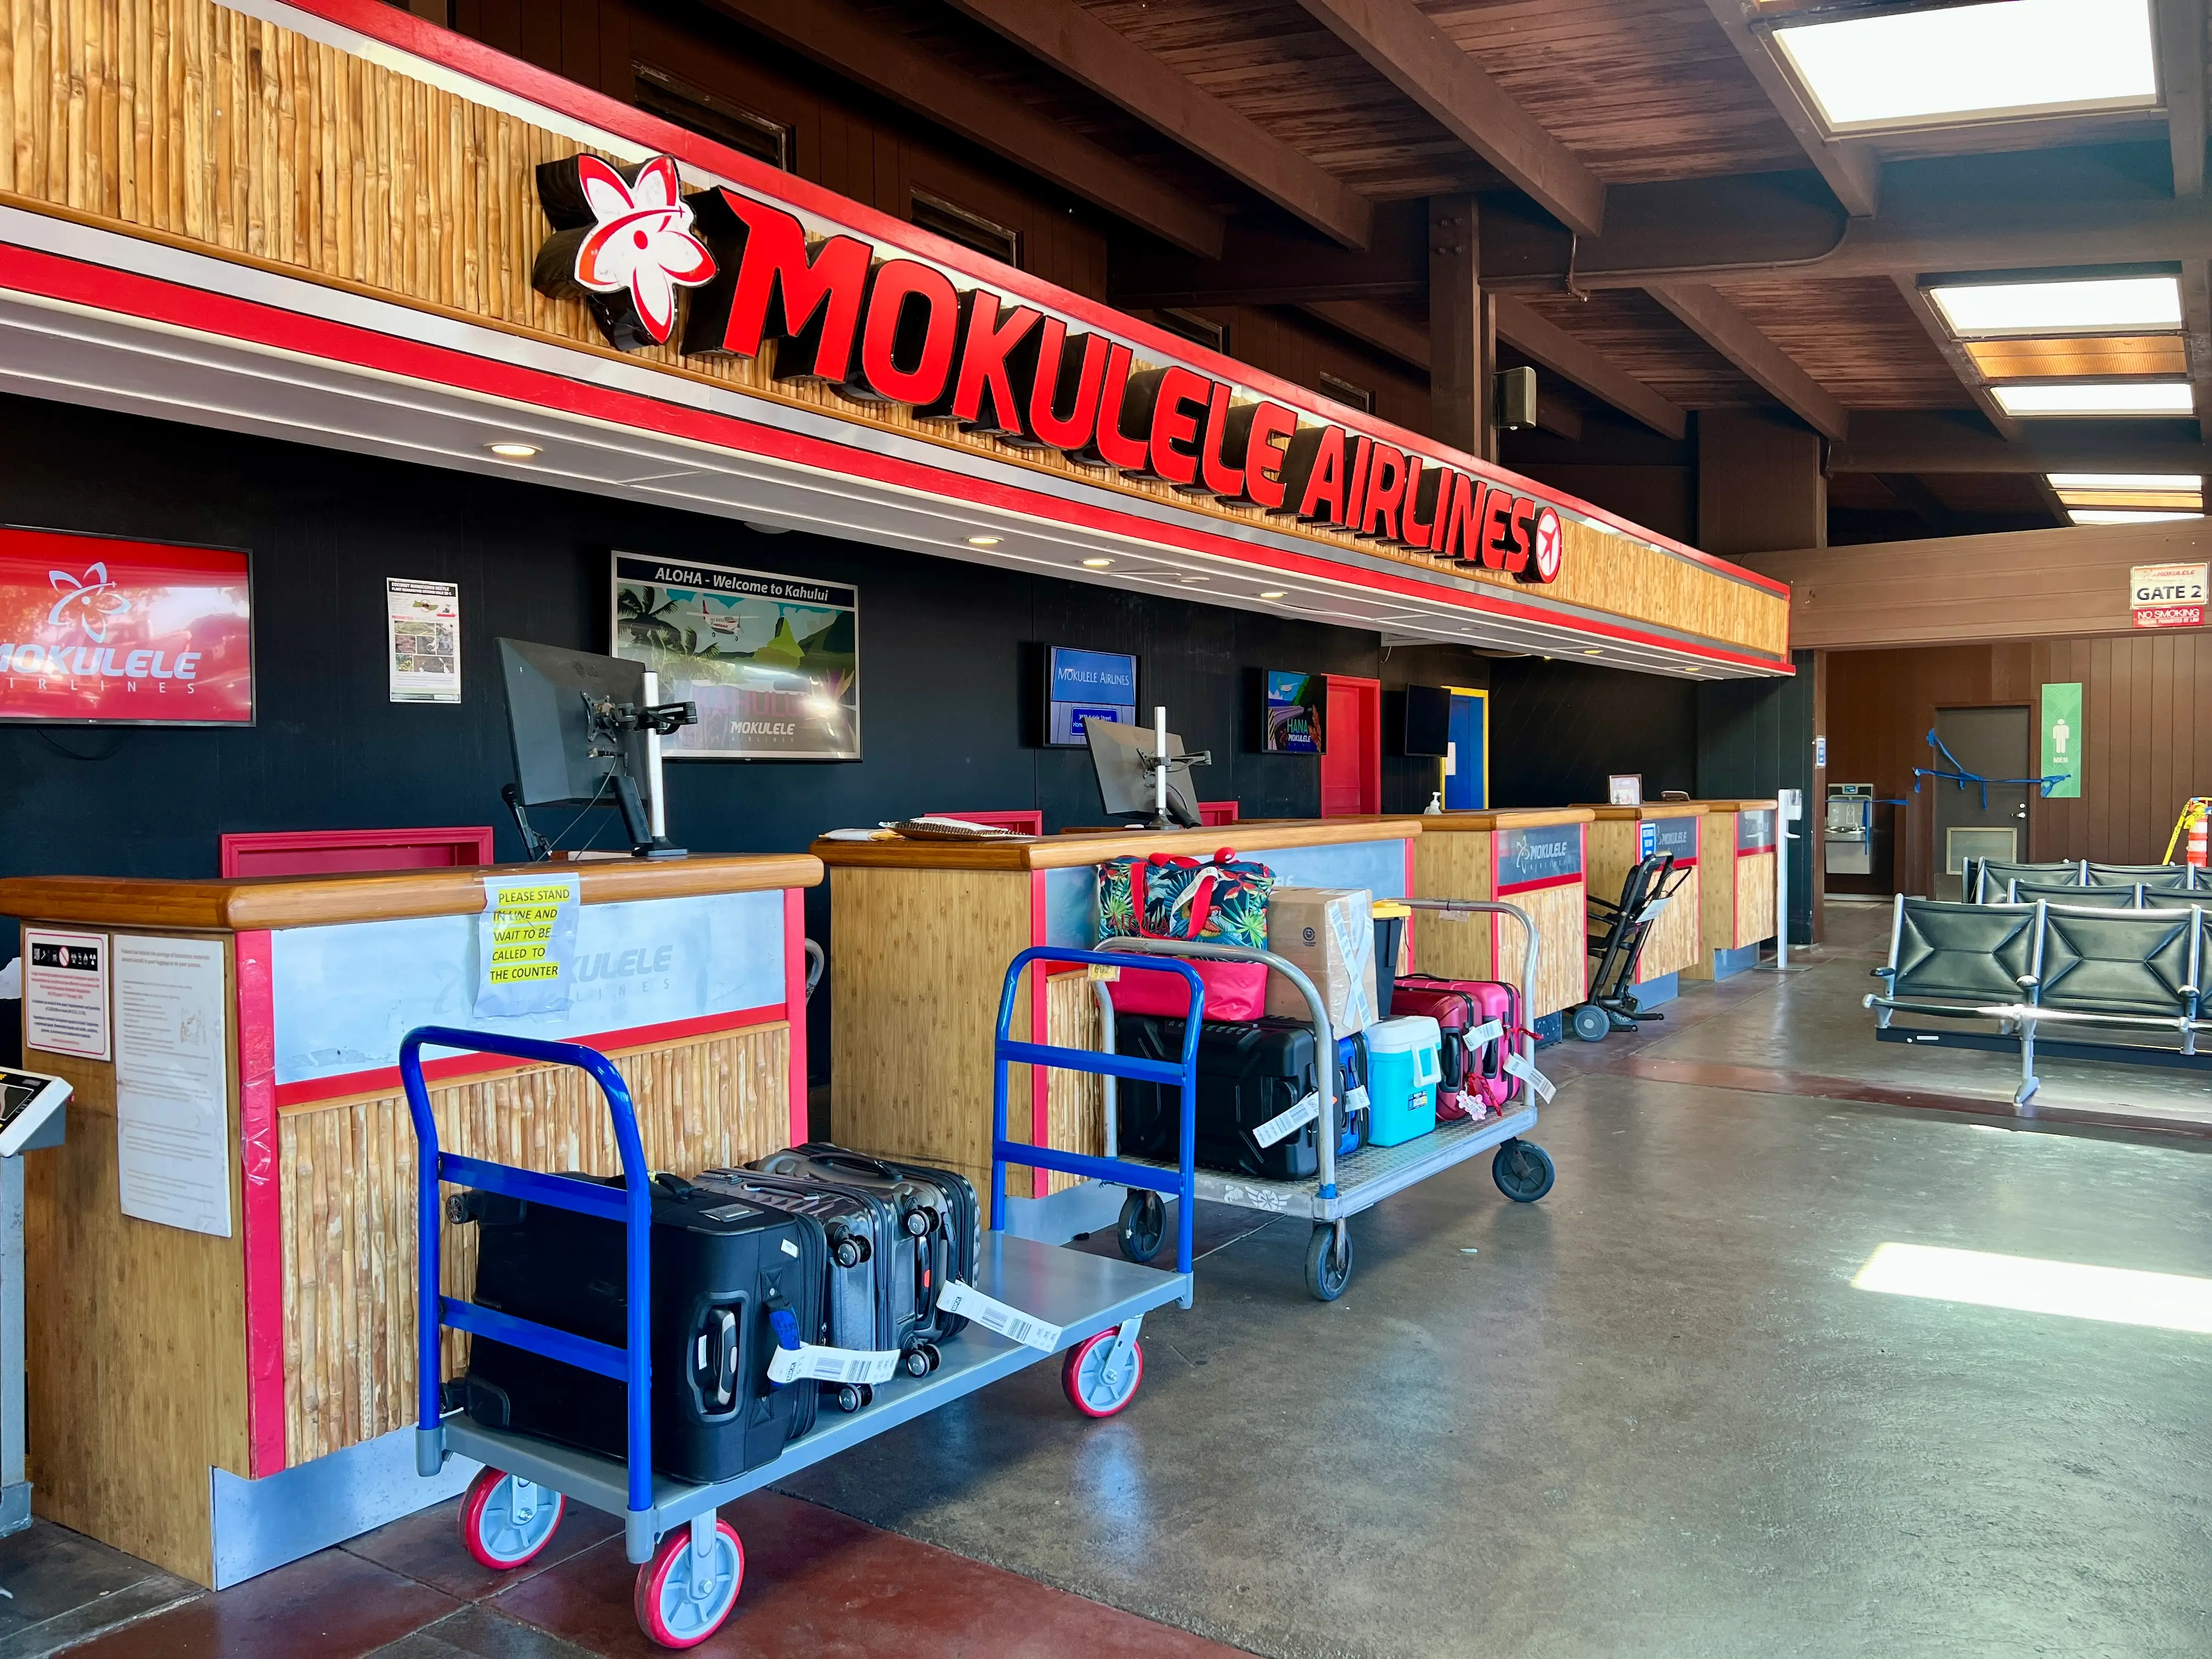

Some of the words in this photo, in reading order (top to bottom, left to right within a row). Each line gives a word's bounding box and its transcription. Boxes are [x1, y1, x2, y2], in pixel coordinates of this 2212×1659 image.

[720, 187, 1298, 509] MOKULELE
[1300, 424, 1536, 573] AIRLINES
[655, 567, 702, 585] ALOHA
[713, 574, 768, 593] Welcome
[770, 583, 782, 595] to
[785, 584, 828, 601] Kahului
[2136, 585, 2186, 600] GATE
[2191, 584, 2202, 598] 2
[2137, 610, 2153, 619] NO
[2154, 608, 2200, 618] SMOKING
[1099, 672, 1130, 686] AIRLINES
[731, 721, 795, 735] MOKULELE
[1286, 718, 1309, 734] HANA
[1288, 733, 1312, 743] MOKULELE
[1661, 831, 1688, 845] MOKULELE
[1530, 841, 1567, 860] MOKULELE
[498, 891, 535, 903] PLEASE
[538, 889, 570, 900] STAND
[493, 910, 506, 922] IN
[509, 910, 532, 921] LINE
[534, 909, 557, 919] AND
[1108, 913, 1171, 934] ALOHA
[493, 930, 521, 941] WAIT
[523, 929, 535, 939] TO
[538, 927, 551, 938] BE
[492, 949, 527, 961] CALLED
[532, 947, 545, 957] TO
[490, 969, 509, 981] THE
[511, 966, 558, 979] COUNTER
[951, 1296, 962, 1312] MKK
